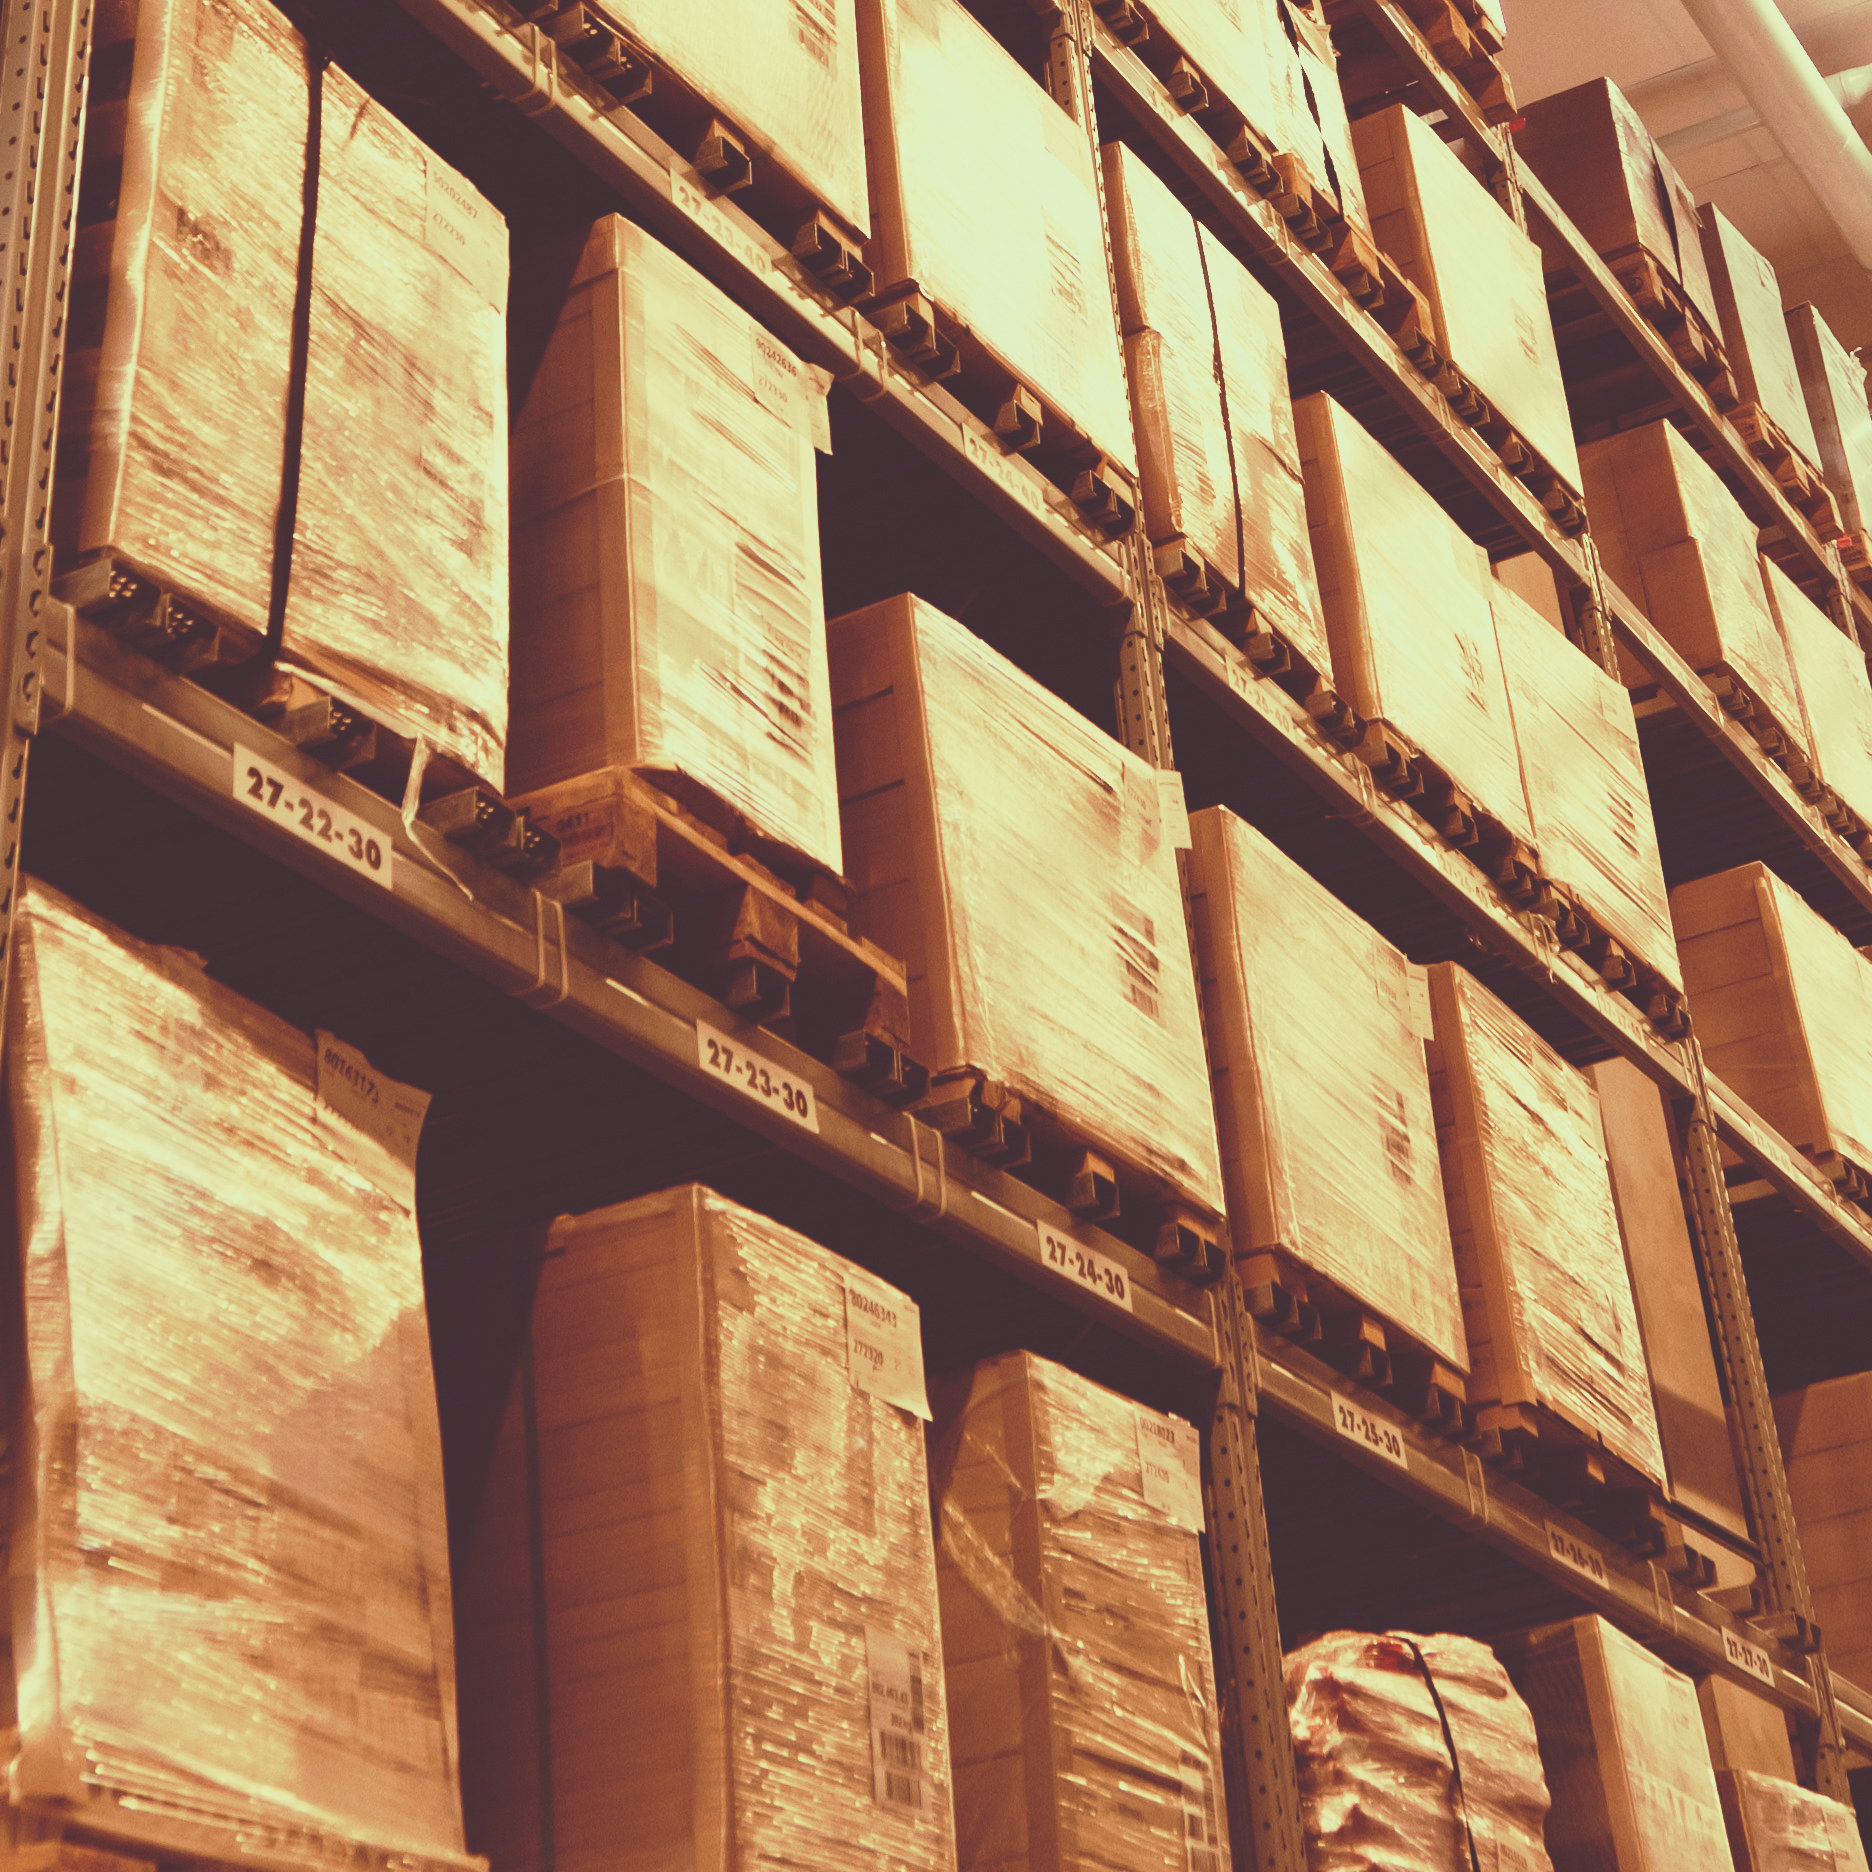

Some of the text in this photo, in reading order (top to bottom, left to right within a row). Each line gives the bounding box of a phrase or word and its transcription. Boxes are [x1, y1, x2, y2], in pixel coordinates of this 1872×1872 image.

[679, 185, 767, 273] 27-23-40
[968, 436, 1040, 512] 27-24-40
[246, 766, 382, 871] 27-22-30
[706, 1037, 809, 1119] 27-23-30
[1045, 1235, 1126, 1300] 27-24-30
[1338, 1404, 1401, 1460] 27-25-30
[1550, 1530, 1603, 1580] 27-26-30
[1726, 1636, 1770, 1679] 27-27-30
